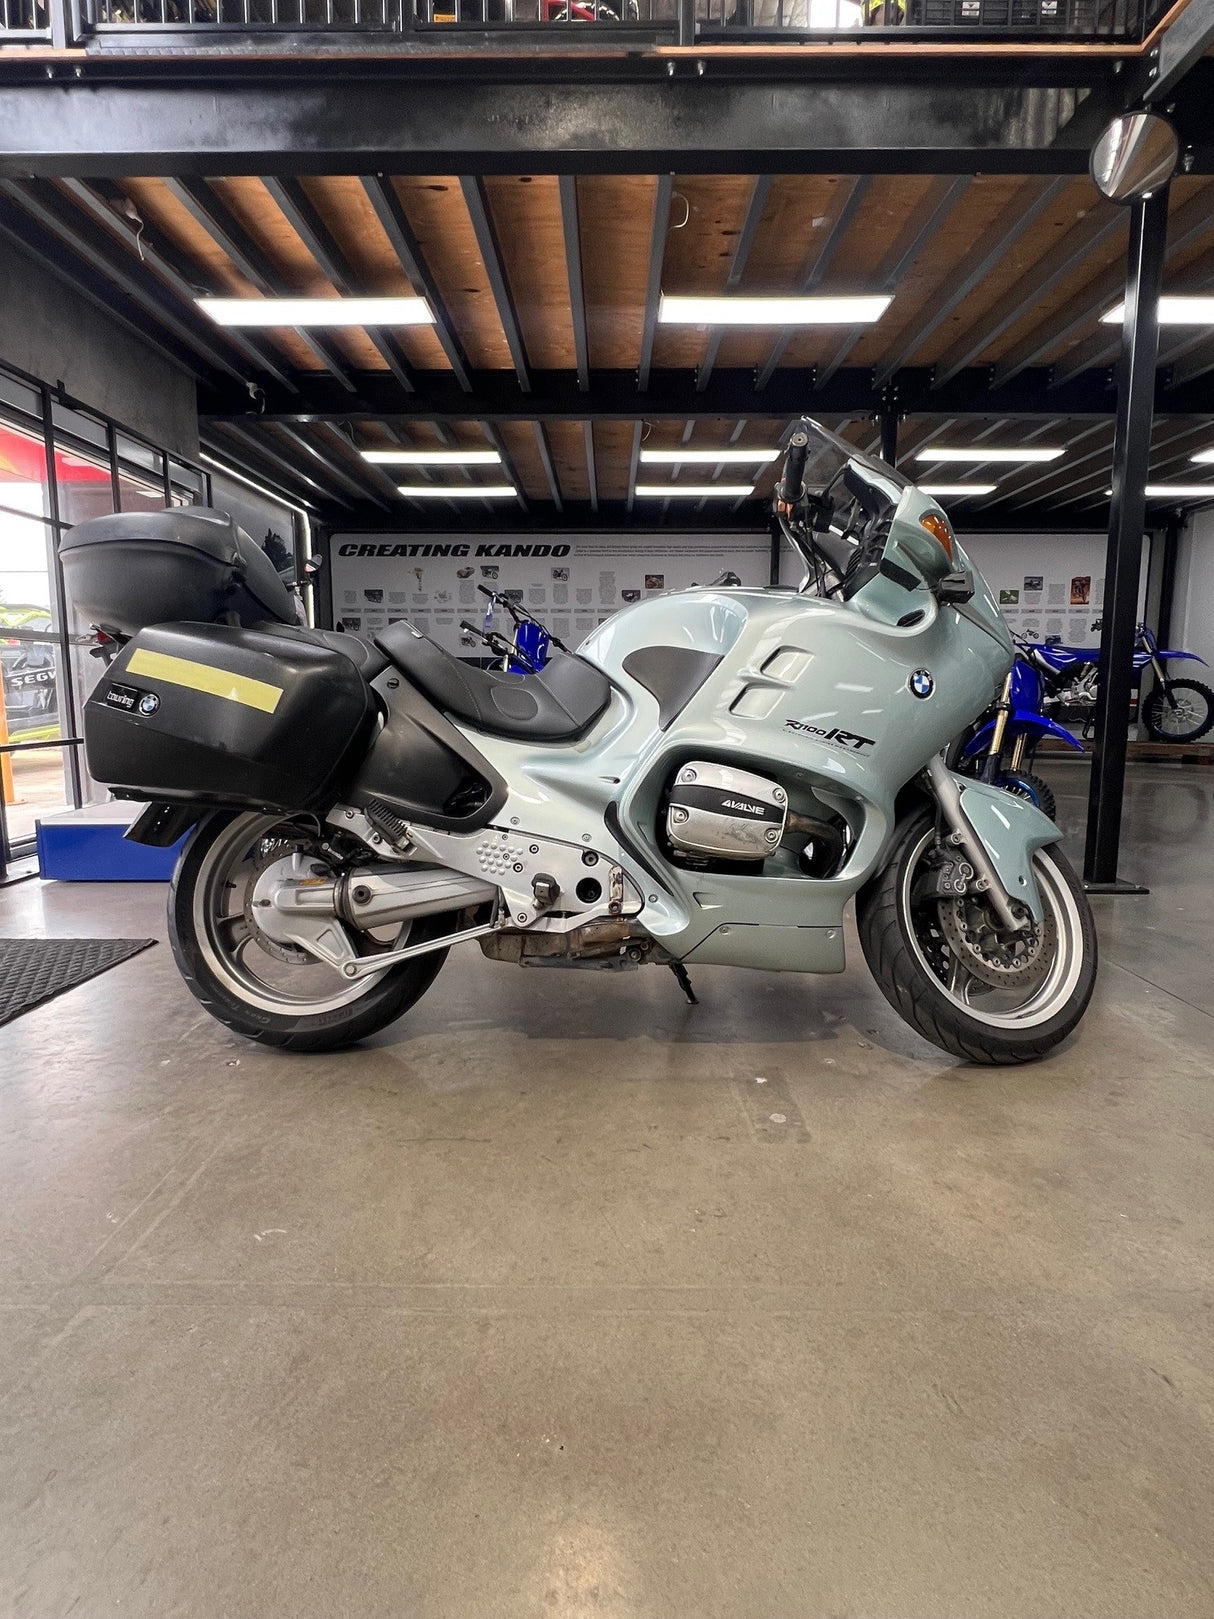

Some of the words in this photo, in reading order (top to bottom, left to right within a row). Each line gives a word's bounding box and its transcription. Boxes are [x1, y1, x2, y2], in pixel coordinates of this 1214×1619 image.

[338, 543, 471, 558] CREATING
[474, 543, 571, 558] KANDO
[106, 690, 135, 708] touring
